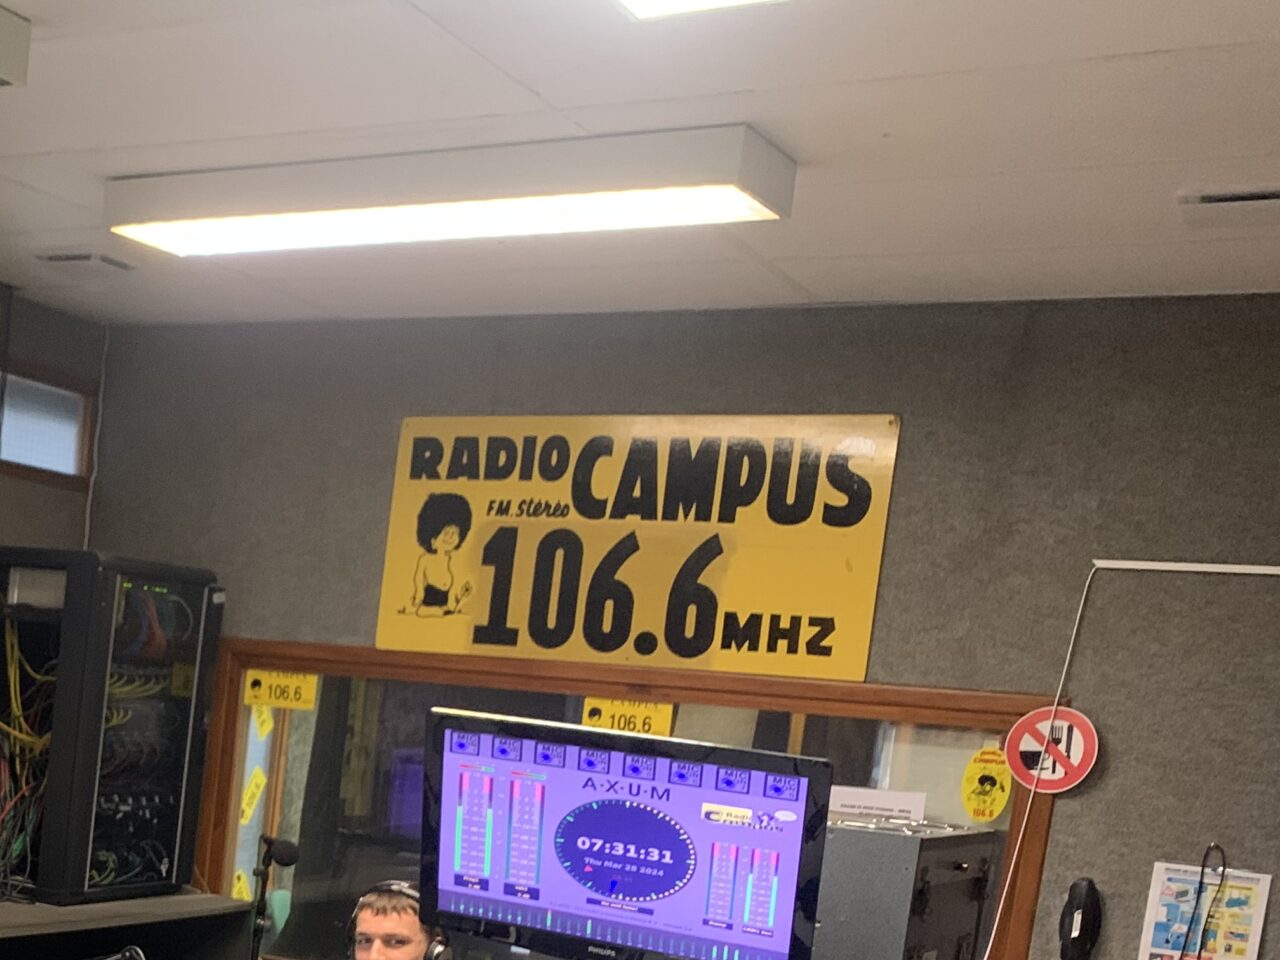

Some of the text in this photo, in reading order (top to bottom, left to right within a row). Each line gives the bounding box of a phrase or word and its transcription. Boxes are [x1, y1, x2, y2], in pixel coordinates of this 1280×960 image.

[409, 434, 873, 529] RADIO CAMPUS
[472, 527, 724, 659] 106.6
[577, 836, 674, 864] 07:31:31
[588, 946, 616, 957] PHILIPS
